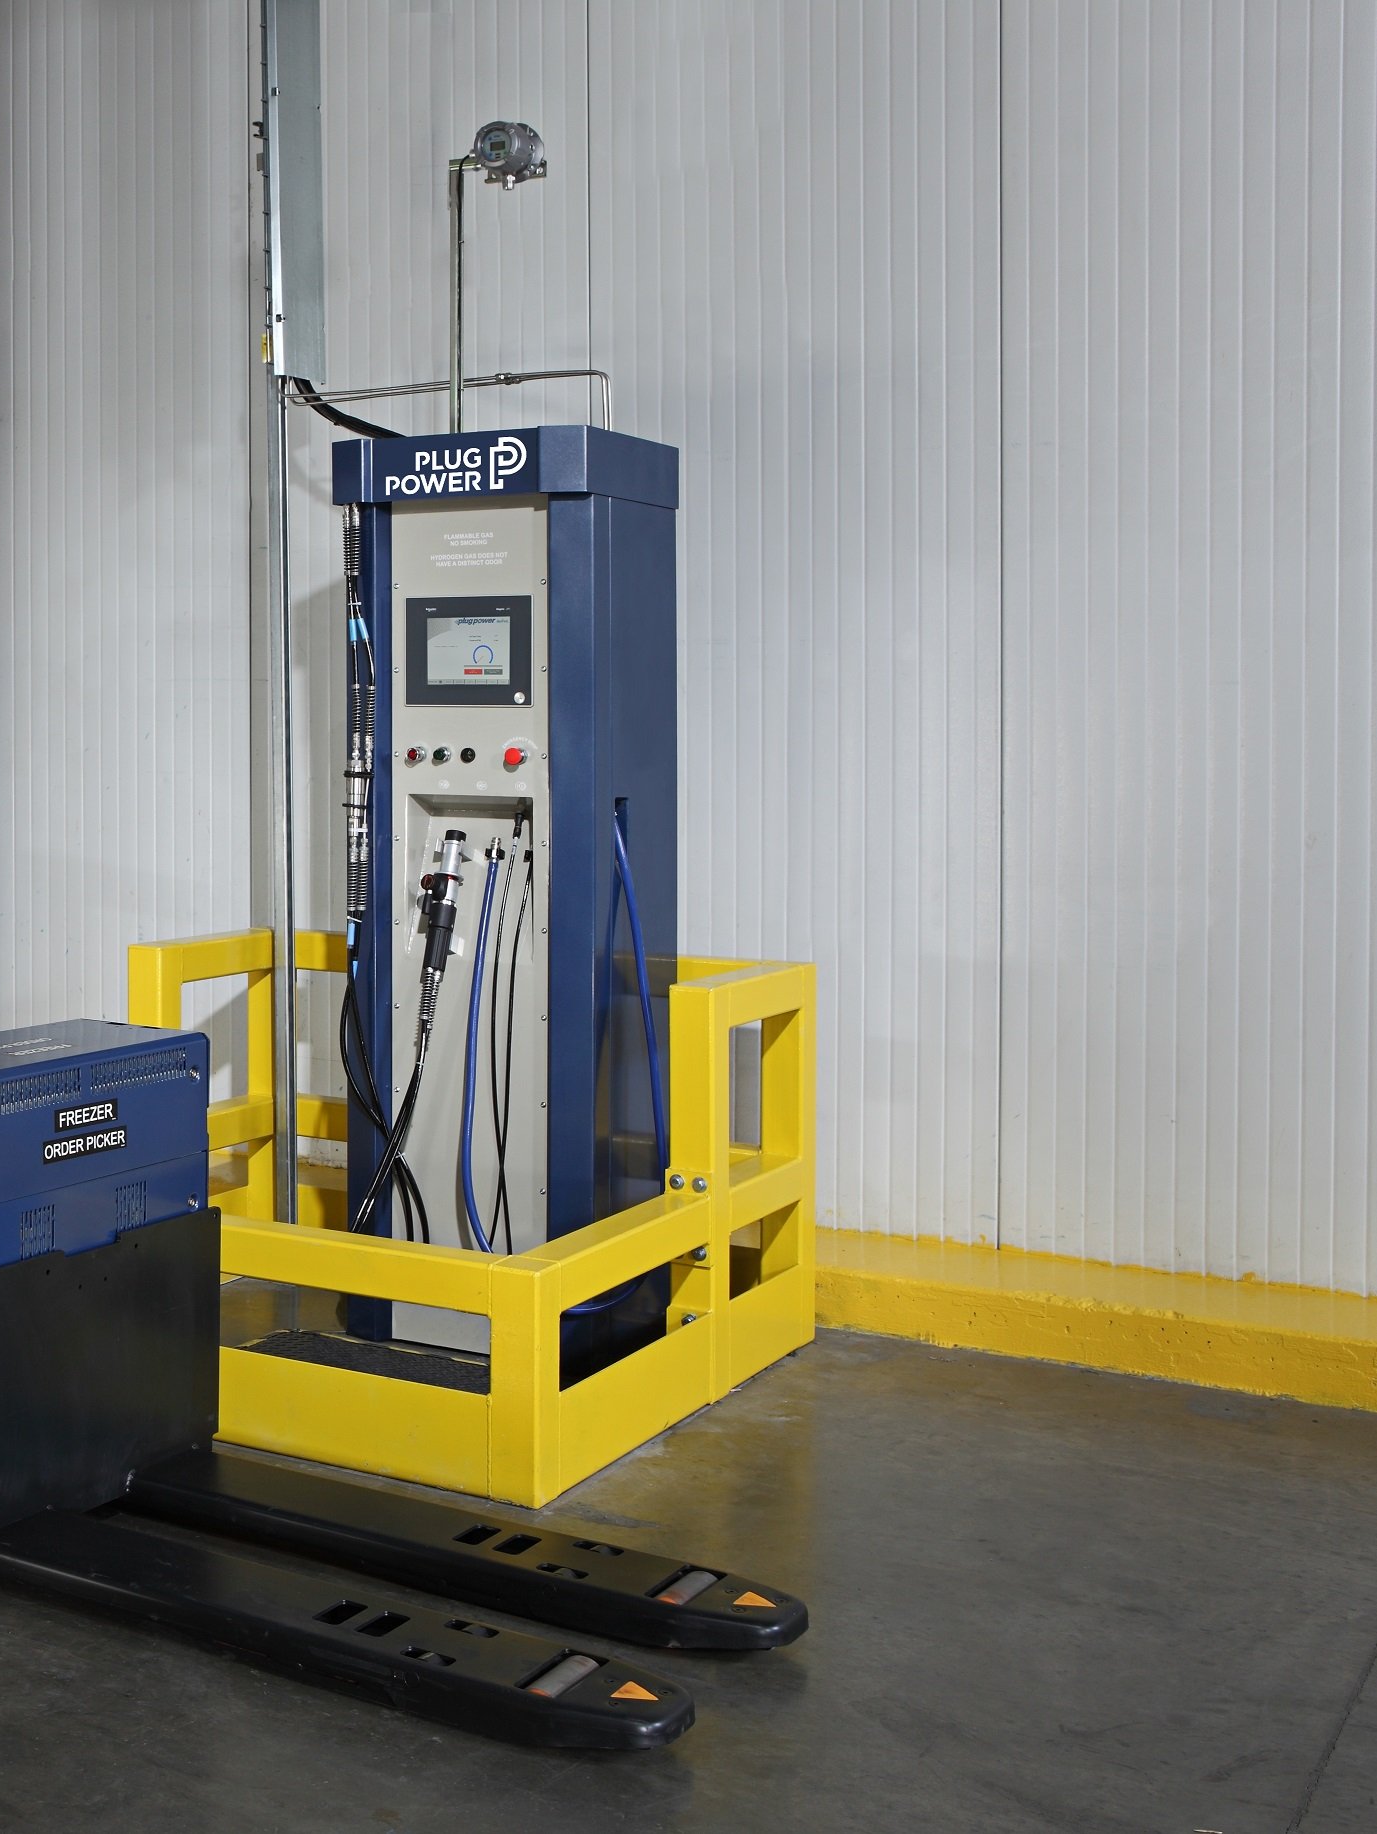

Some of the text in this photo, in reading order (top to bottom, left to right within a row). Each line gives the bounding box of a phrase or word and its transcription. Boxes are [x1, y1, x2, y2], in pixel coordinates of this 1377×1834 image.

[415, 447, 482, 472] PLUG
[385, 470, 482, 496] POWER
[444, 532, 480, 540] FLAMMABLE
[430, 553, 463, 561] HYDROGEN
[457, 559, 484, 567] DISTINCT
[59, 1103, 113, 1128] FREEZER
[44, 1130, 126, 1160] ORDER PICKER
